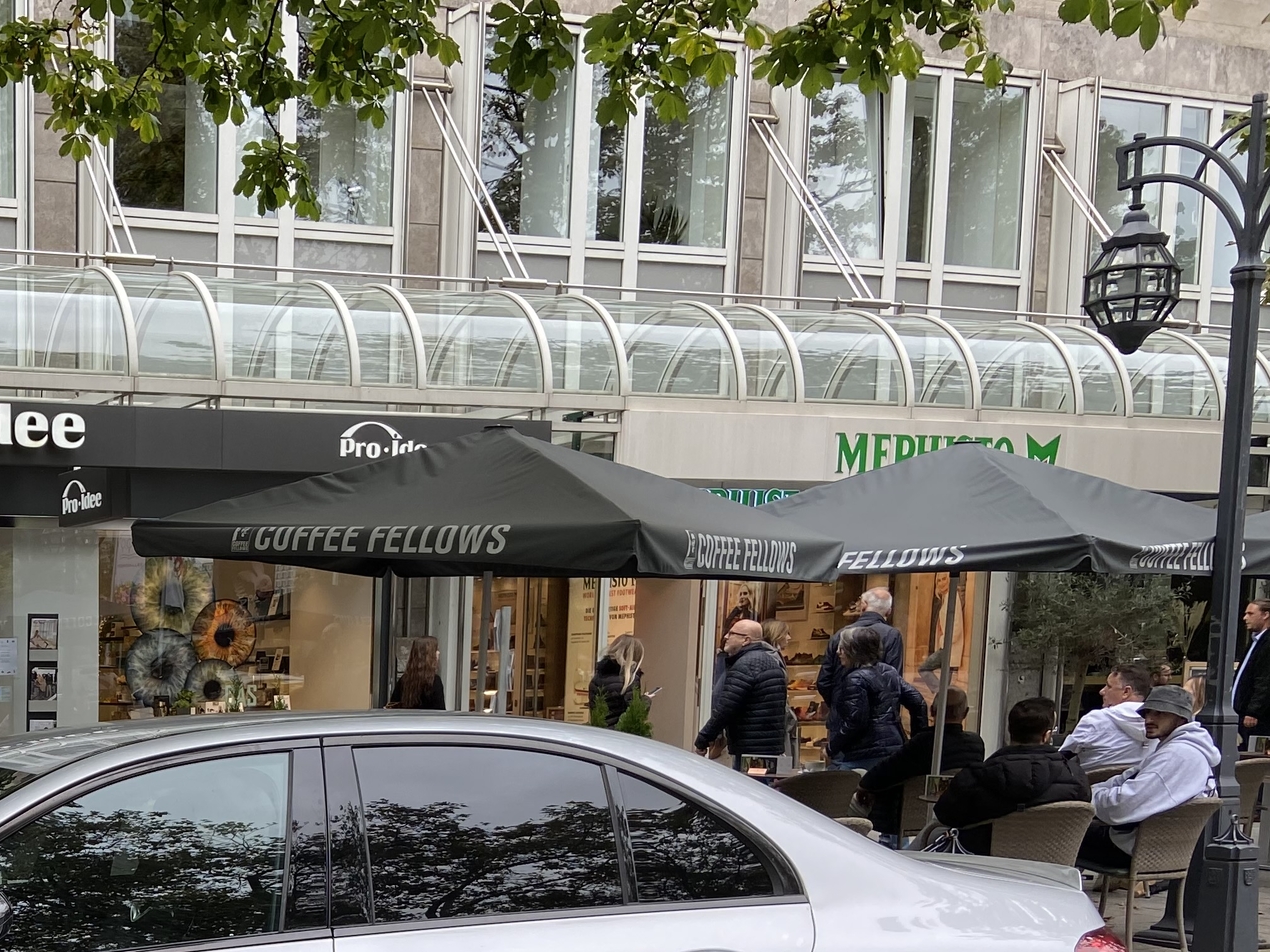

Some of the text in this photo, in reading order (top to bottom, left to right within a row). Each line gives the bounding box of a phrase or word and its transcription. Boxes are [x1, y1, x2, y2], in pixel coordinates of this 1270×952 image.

[254, 524, 511, 555] COFFEE FELLOWS
[696, 532, 741, 571] COFFEE
[742, 538, 797, 574] FELLOWS
[836, 544, 968, 570] FELLOWS
